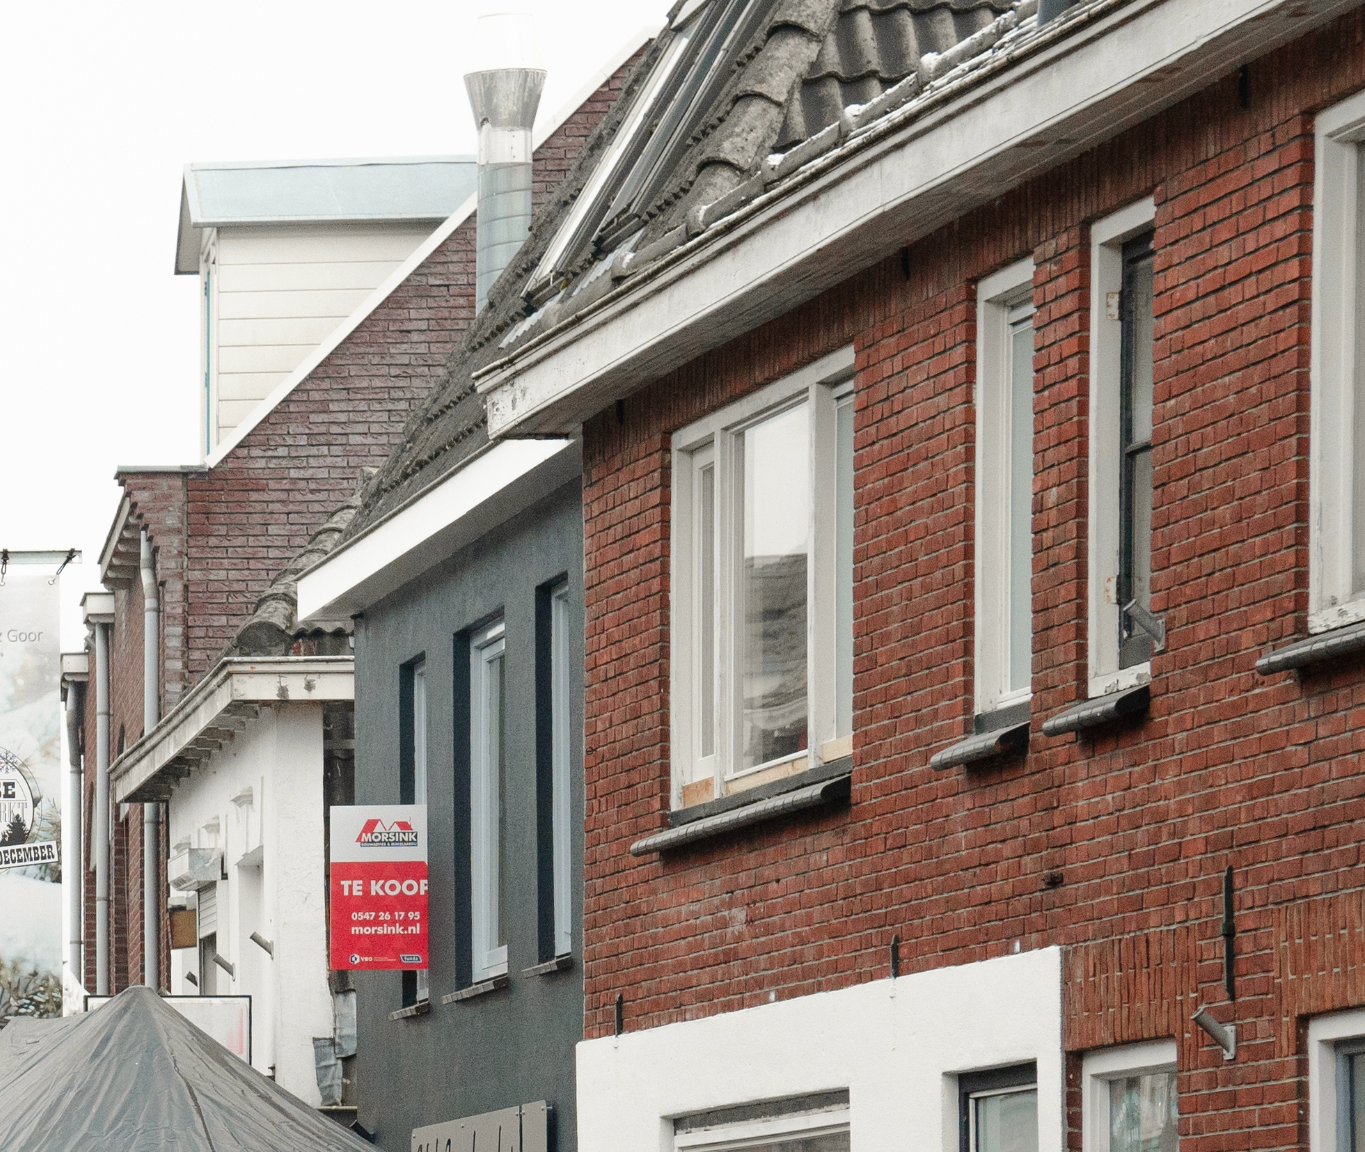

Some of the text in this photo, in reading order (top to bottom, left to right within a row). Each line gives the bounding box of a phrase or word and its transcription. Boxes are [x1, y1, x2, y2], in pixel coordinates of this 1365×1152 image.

[7, 629, 44, 643] Goor
[361, 832, 417, 842] MORSINK
[340, 880, 363, 896] TE
[351, 912, 420, 920] 0547 26 17 95
[351, 923, 420, 935] morsink.nl
